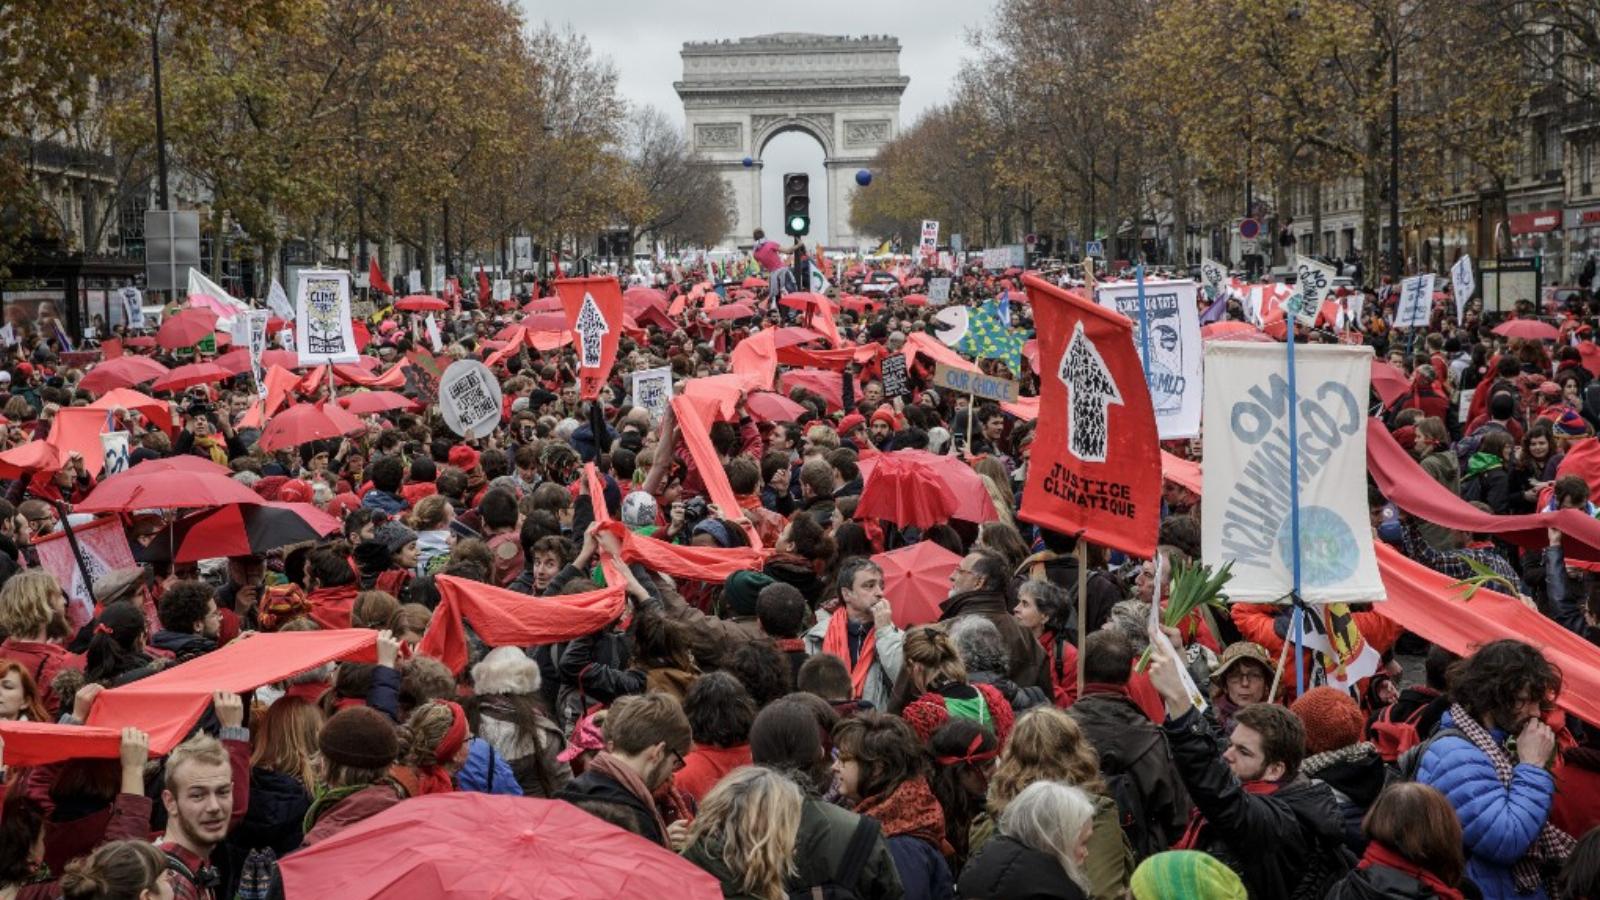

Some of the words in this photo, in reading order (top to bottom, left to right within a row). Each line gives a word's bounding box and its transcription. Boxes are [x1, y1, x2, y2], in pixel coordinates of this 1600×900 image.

[1312, 270, 1327, 288] NO
[946, 370, 969, 389] OUR
[971, 377, 1010, 400] CHOICE
[1043, 476, 1136, 518] CLIMATIQUE
[1051, 462, 1131, 500] JUSTICE
